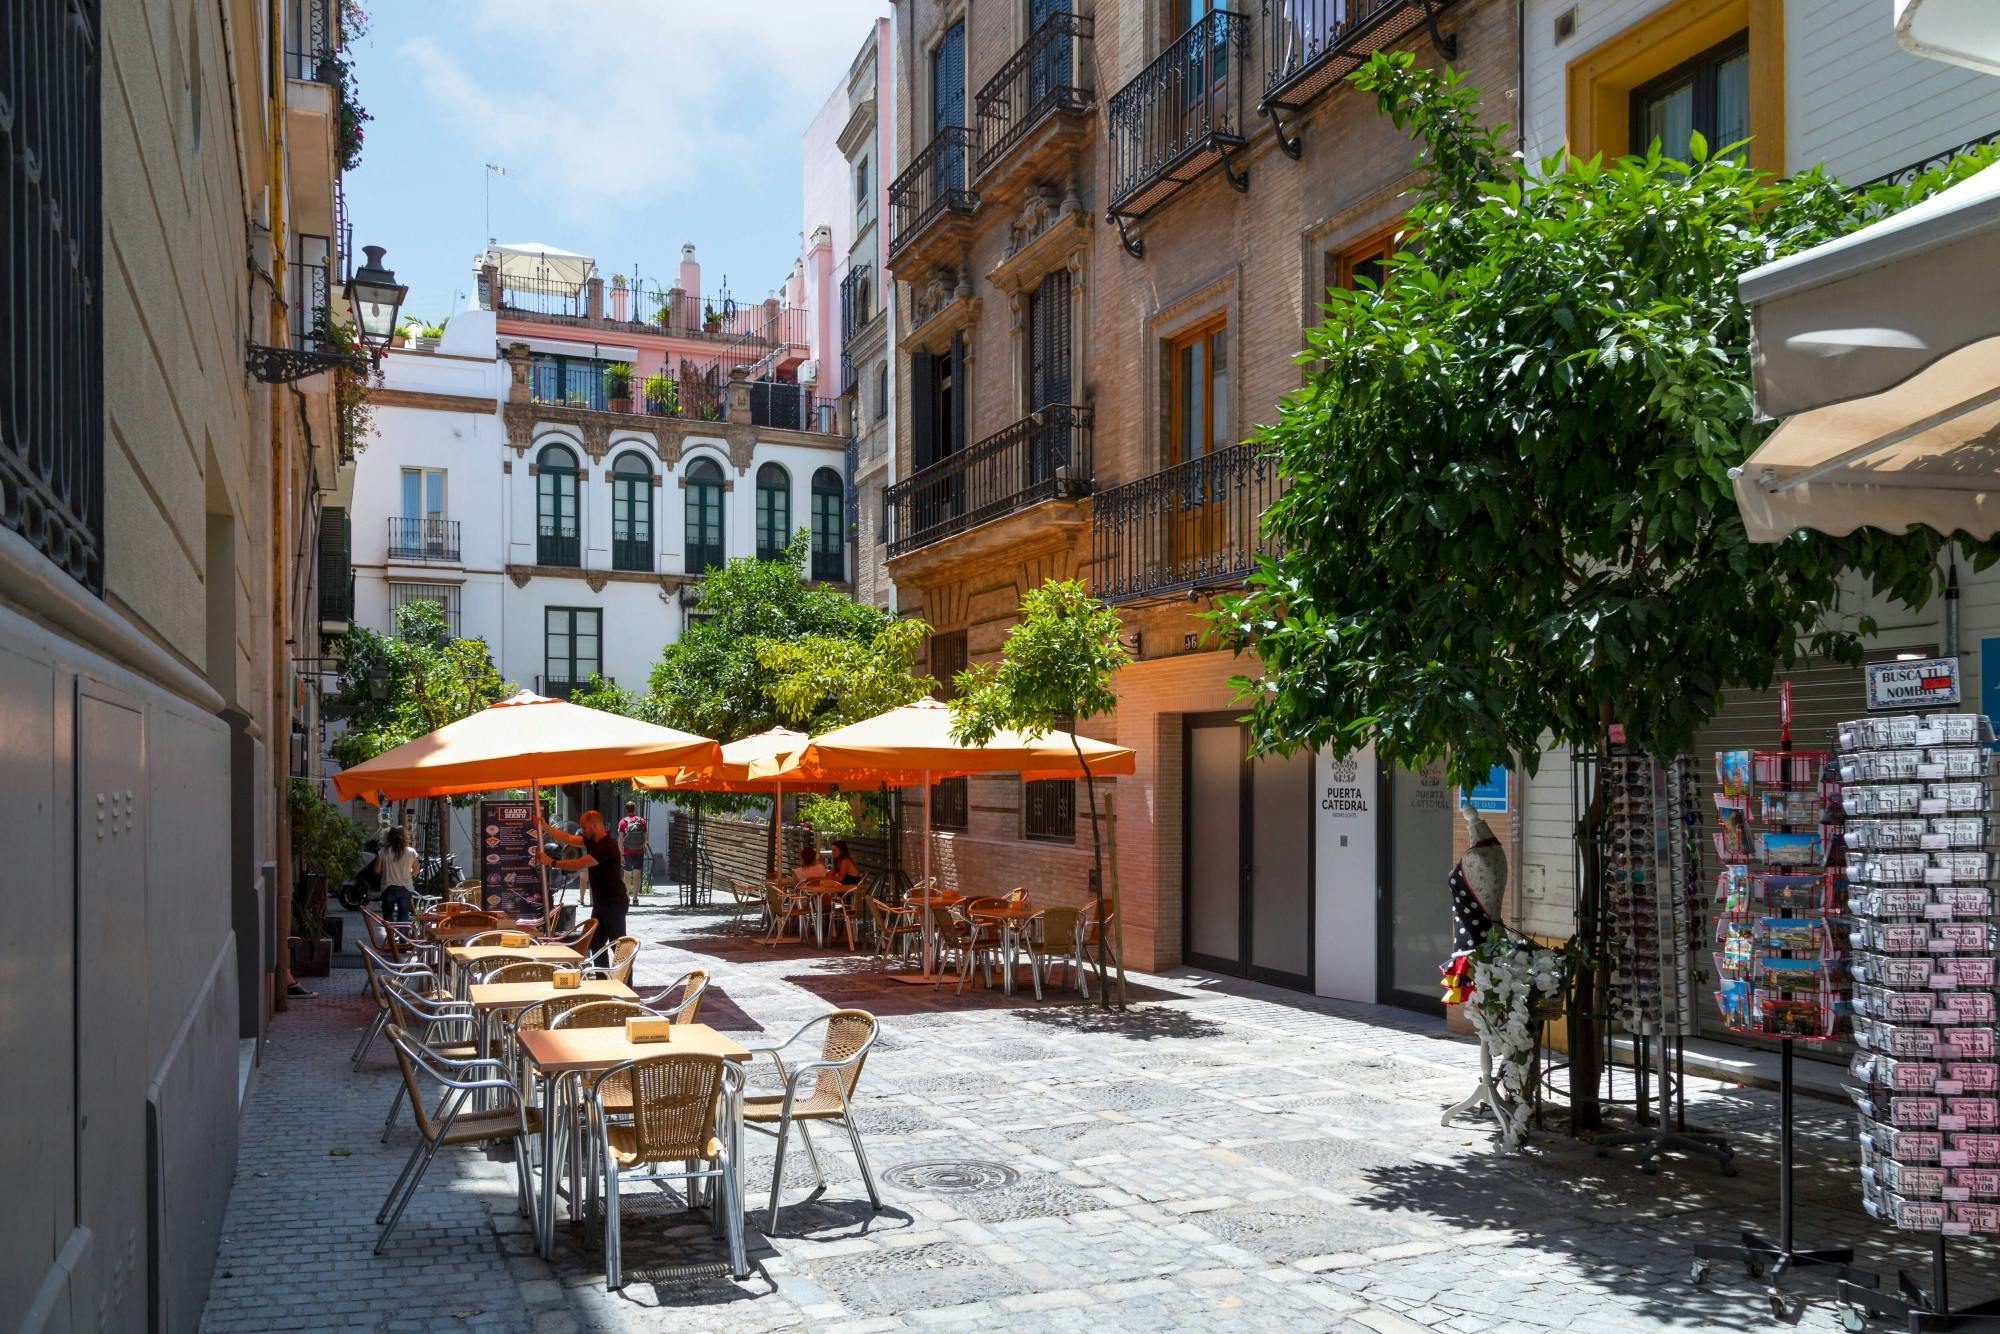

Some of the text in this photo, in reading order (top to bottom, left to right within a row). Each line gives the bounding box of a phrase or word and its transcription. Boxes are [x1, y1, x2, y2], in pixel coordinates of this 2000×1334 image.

[1882, 669, 1922, 683] BUSCA
[1327, 787, 1362, 799] PUERTA
[1321, 799, 1369, 811] CATEDRAL
[1965, 1140, 1994, 1148] Sevilla
[1908, 1207, 1937, 1215] Sevilla
[1963, 1209, 1992, 1217] Sevilla
